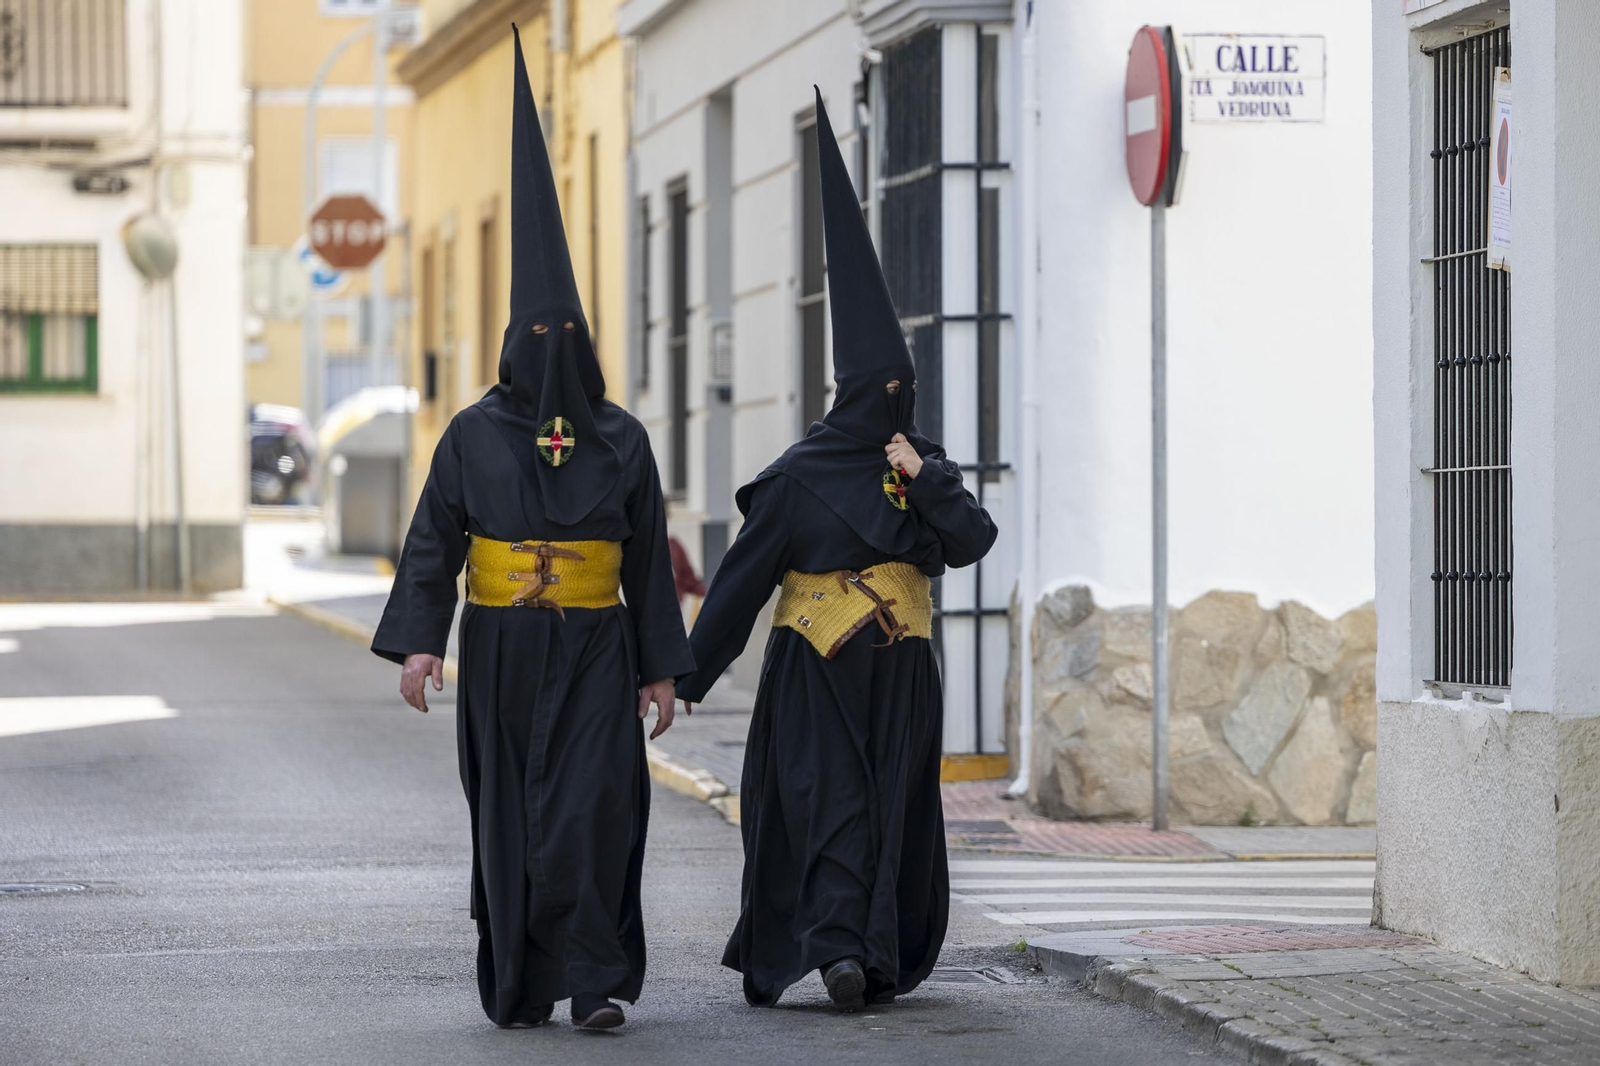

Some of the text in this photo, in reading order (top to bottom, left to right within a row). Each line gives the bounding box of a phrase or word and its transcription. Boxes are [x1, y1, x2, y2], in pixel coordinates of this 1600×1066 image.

[1216, 44, 1300, 73] CALLE
[1227, 80, 1304, 97] JOAQUINA
[1217, 100, 1292, 117] VEDRUNA
[312, 218, 383, 247] STOP
